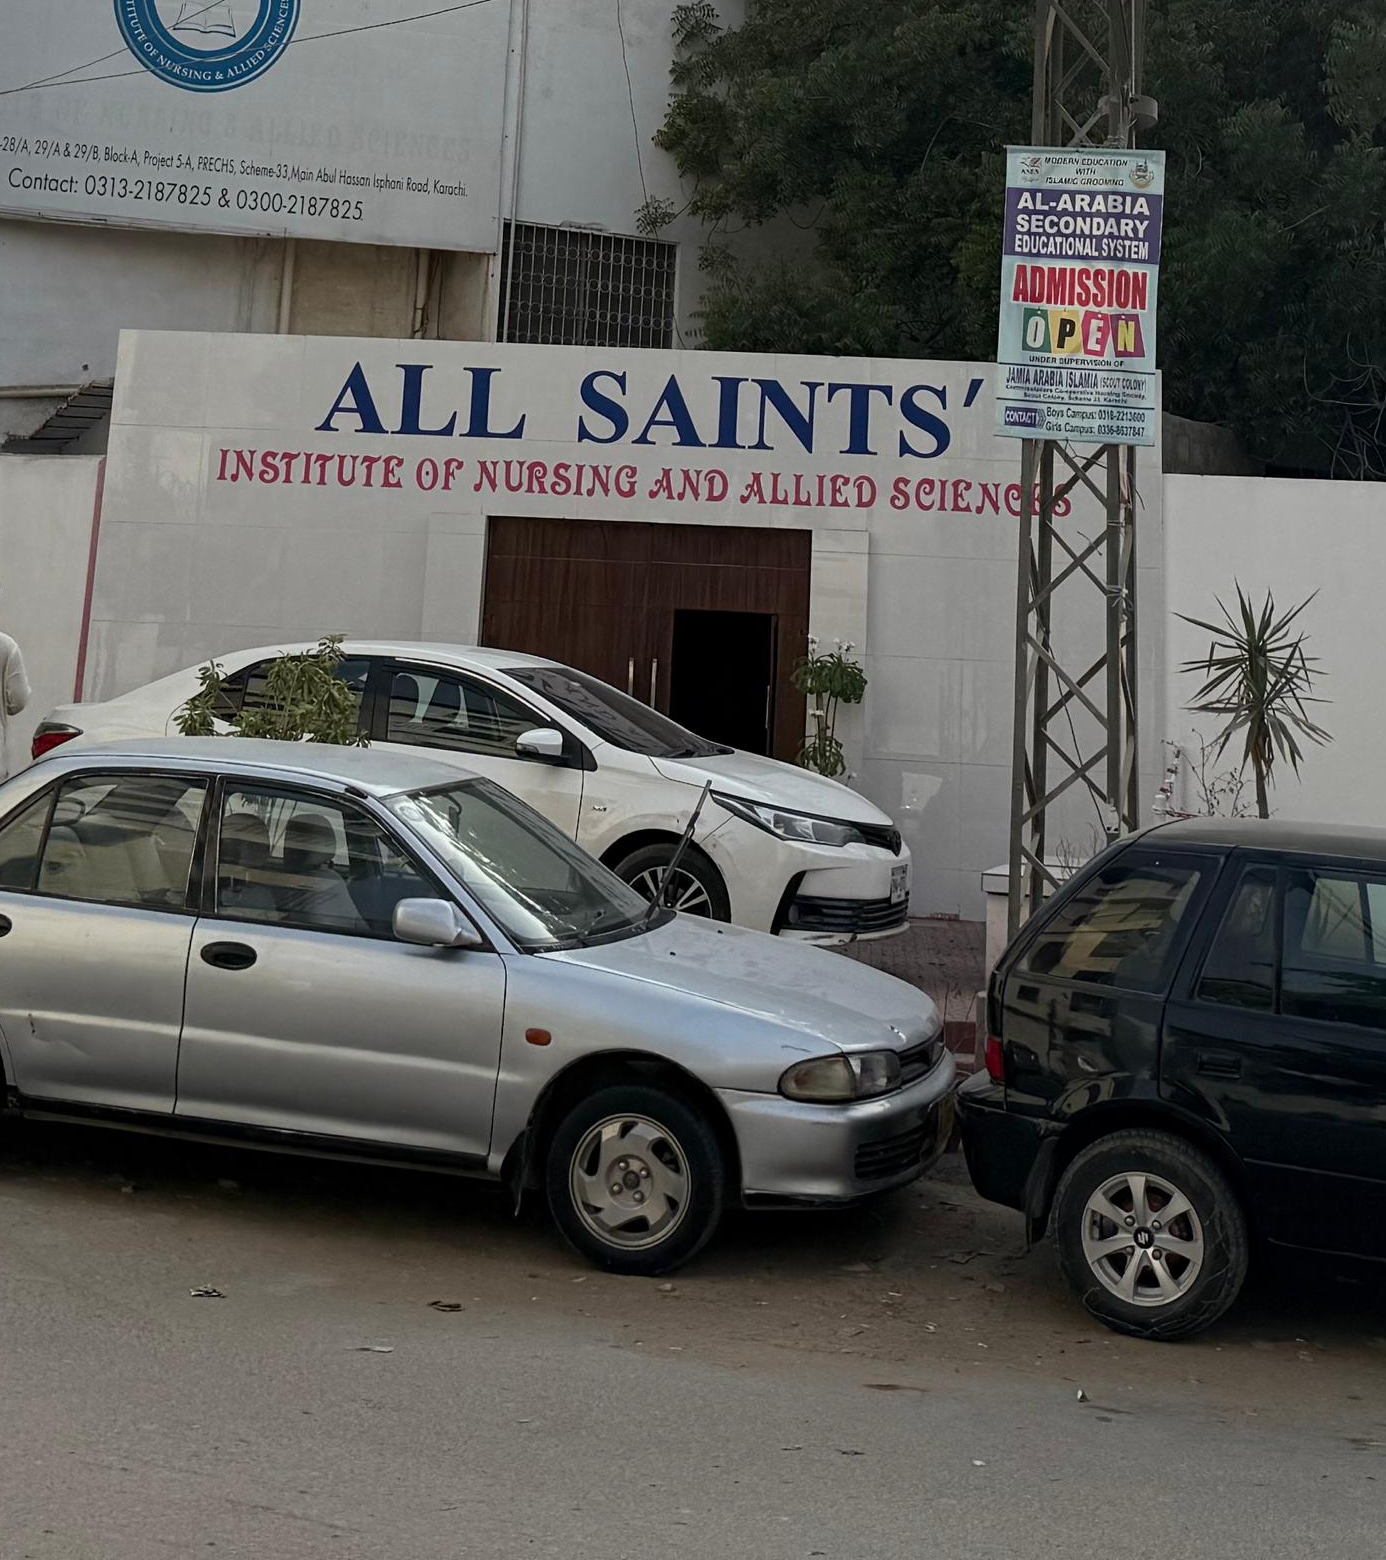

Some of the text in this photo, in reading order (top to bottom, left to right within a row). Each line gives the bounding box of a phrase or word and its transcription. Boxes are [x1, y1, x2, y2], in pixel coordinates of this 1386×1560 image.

[144, 42, 158, 56] OF
[157, 55, 212, 81] NURSING
[215, 71, 224, 80] &
[227, 50, 266, 78] ALLIED
[34, 139, 60, 159] 29/A
[63, 142, 71, 158] &
[74, 143, 101, 163] 29/B,
[104, 146, 140, 167] Block-A,
[143, 150, 174, 171] Project
[176, 153, 194, 172] 5-A,
[197, 155, 237, 176] PRECHS,
[316, 167, 337, 184] Abul
[339, 169, 370, 188] Hassan
[373, 173, 404, 192] Isphani
[406, 177, 431, 194] Road,
[1082, 157, 1128, 167] EDUCATION
[8, 167, 79, 194] Contact:
[84, 174, 212, 206] 0313-2187825
[218, 187, 230, 209] &
[1045, 177, 1078, 185] ISLAMIC
[1080, 178, 1124, 186] GROOMING
[1017, 192, 1150, 215] AL-ARABIA
[1016, 214, 1150, 238] SECONDARY
[1015, 234, 1149, 260] EDUCATIONAL SYSTEM
[1013, 264, 1148, 310] ADMISSION
[1026, 315, 1135, 352] OPEN
[1029, 355, 1056, 364] UNDER
[1059, 357, 1111, 367] SUPERVISION
[1006, 367, 1030, 383] JAMIA
[1033, 369, 1063, 387] ARABIA
[1066, 370, 1098, 389] ISLAMIA
[314, 361, 984, 458] ALL SAINTS'
[1006, 409, 1036, 423] CONTACT
[1047, 406, 1064, 418] Boys
[1066, 408, 1096, 420] Campus:
[1046, 421, 1062, 432] Girls
[1065, 423, 1096, 435] Campus:
[216, 447, 404, 489] INSTITUTE
[415, 456, 464, 492] OF
[473, 459, 639, 502] NURSING
[648, 467, 729, 504] AND
[739, 470, 878, 509] ALLIED
